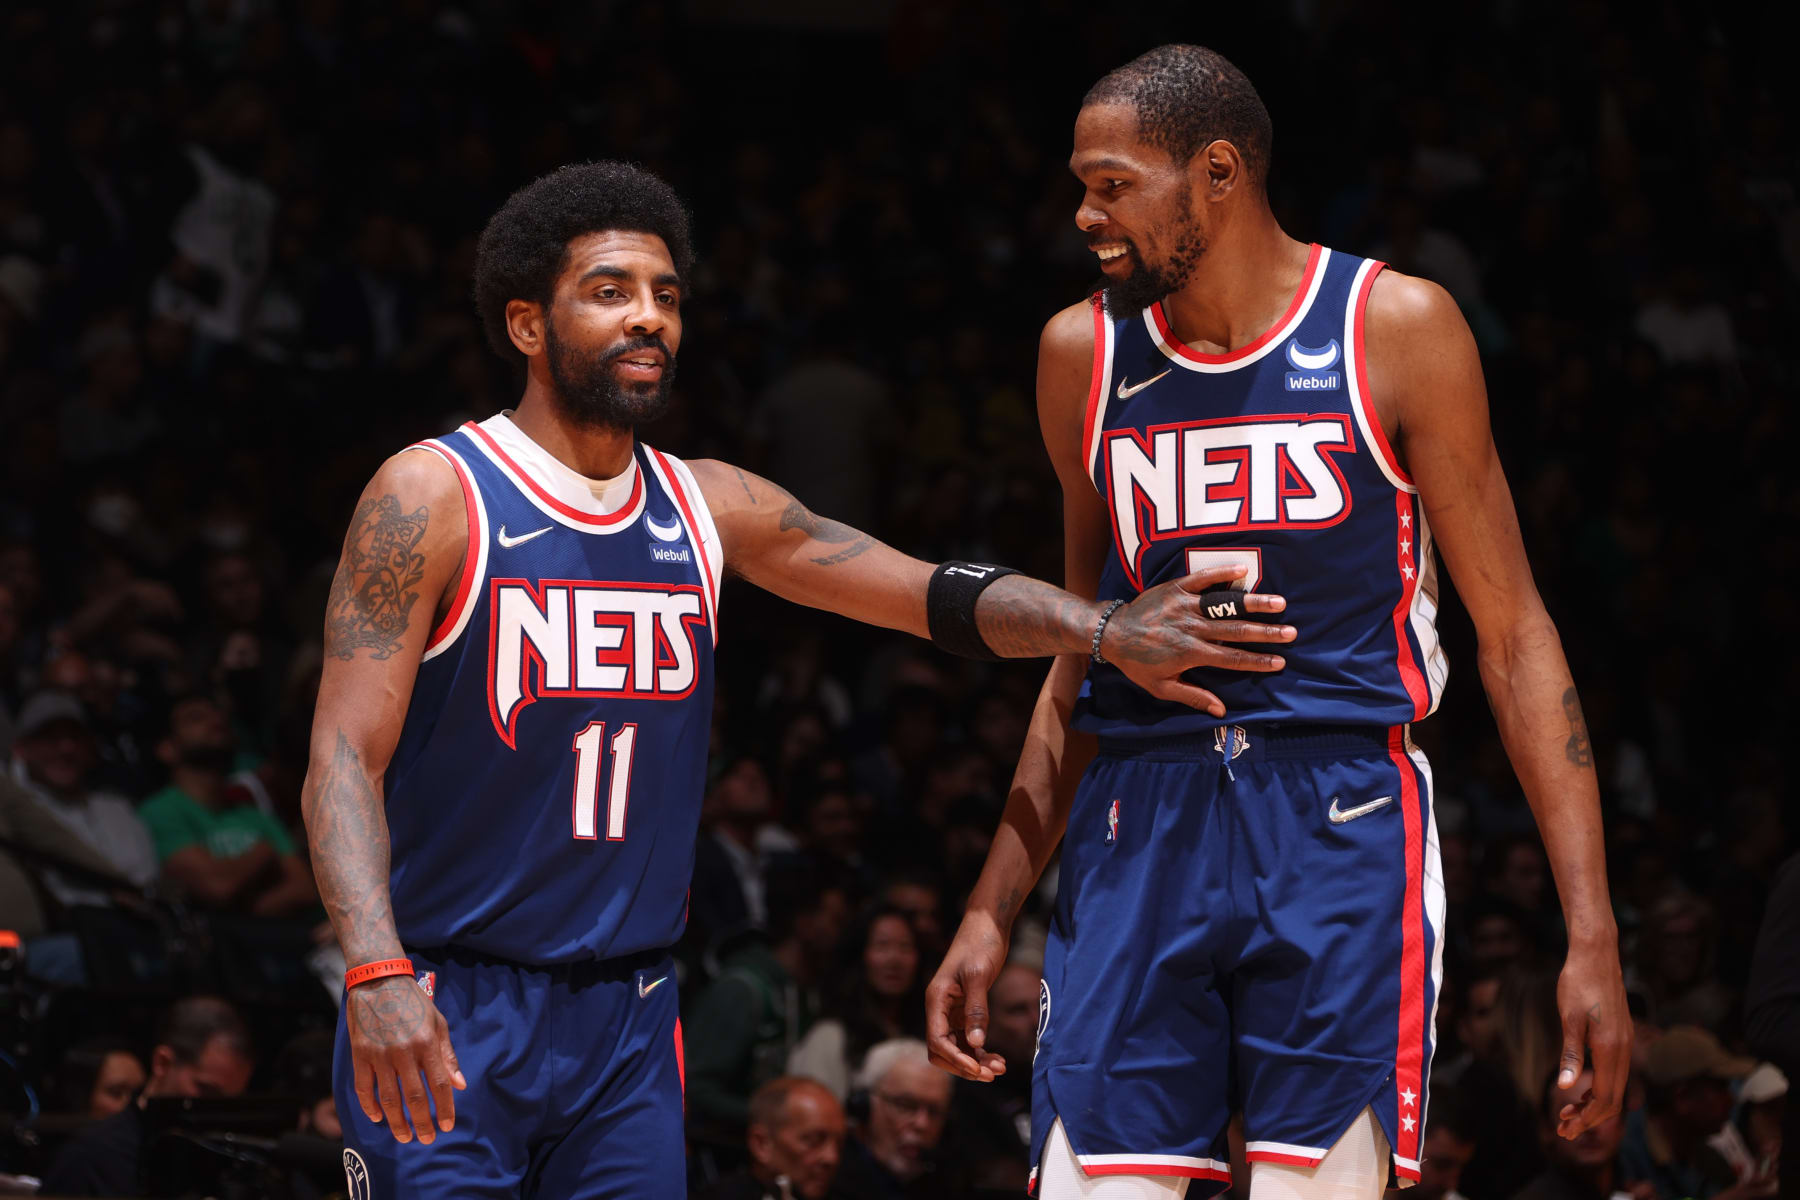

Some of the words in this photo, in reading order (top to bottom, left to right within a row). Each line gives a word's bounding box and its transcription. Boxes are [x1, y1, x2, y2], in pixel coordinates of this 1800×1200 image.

[1290, 376, 1337, 390] Webull
[1102, 413, 1356, 592] NETS
[653, 548, 690, 563] Webull
[1207, 601, 1238, 618] KAI
[487, 578, 706, 750] NETS
[572, 721, 638, 841] 11
